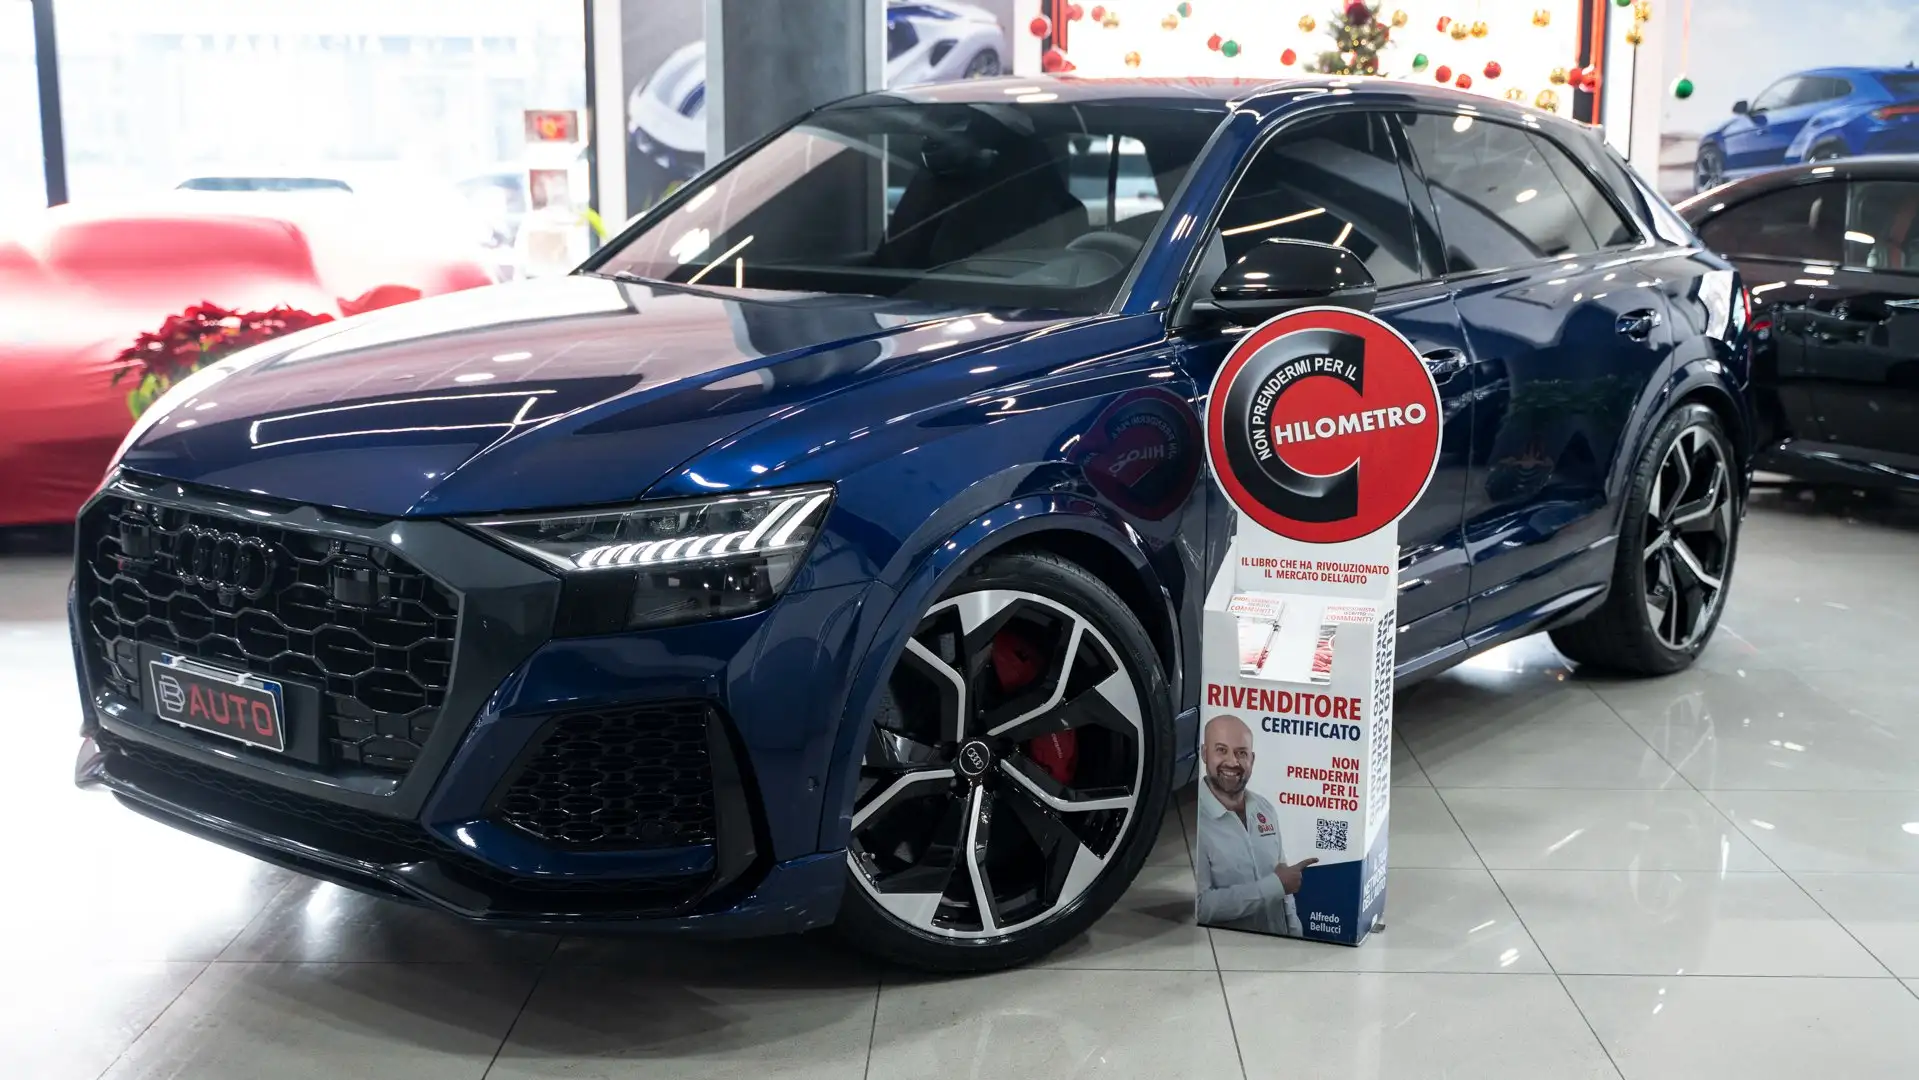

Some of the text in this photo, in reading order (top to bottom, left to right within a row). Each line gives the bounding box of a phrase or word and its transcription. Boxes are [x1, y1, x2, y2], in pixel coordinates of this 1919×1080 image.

[1252, 357, 1357, 461] NON PRENDERMI PER IL
[1241, 557, 1389, 575] IL LIBRO CHE HA RIVOLUZIONATO
[1264, 569, 1367, 584] IL MERCATO DELL'AUTO
[1384, 637, 1393, 711] LIBRO
[189, 683, 274, 737] AUTO
[1207, 683, 1362, 721] RIVENDITORE
[1261, 716, 1361, 742] CERTIFICATO
[1332, 756, 1360, 771] NON
[1287, 766, 1359, 784] PRENDERMI
[1322, 783, 1359, 798] PER IL
[1279, 792, 1358, 812] CHILOMETRO
[1310, 911, 1340, 923] Alfredo
[1310, 922, 1341, 934] Bellucci
